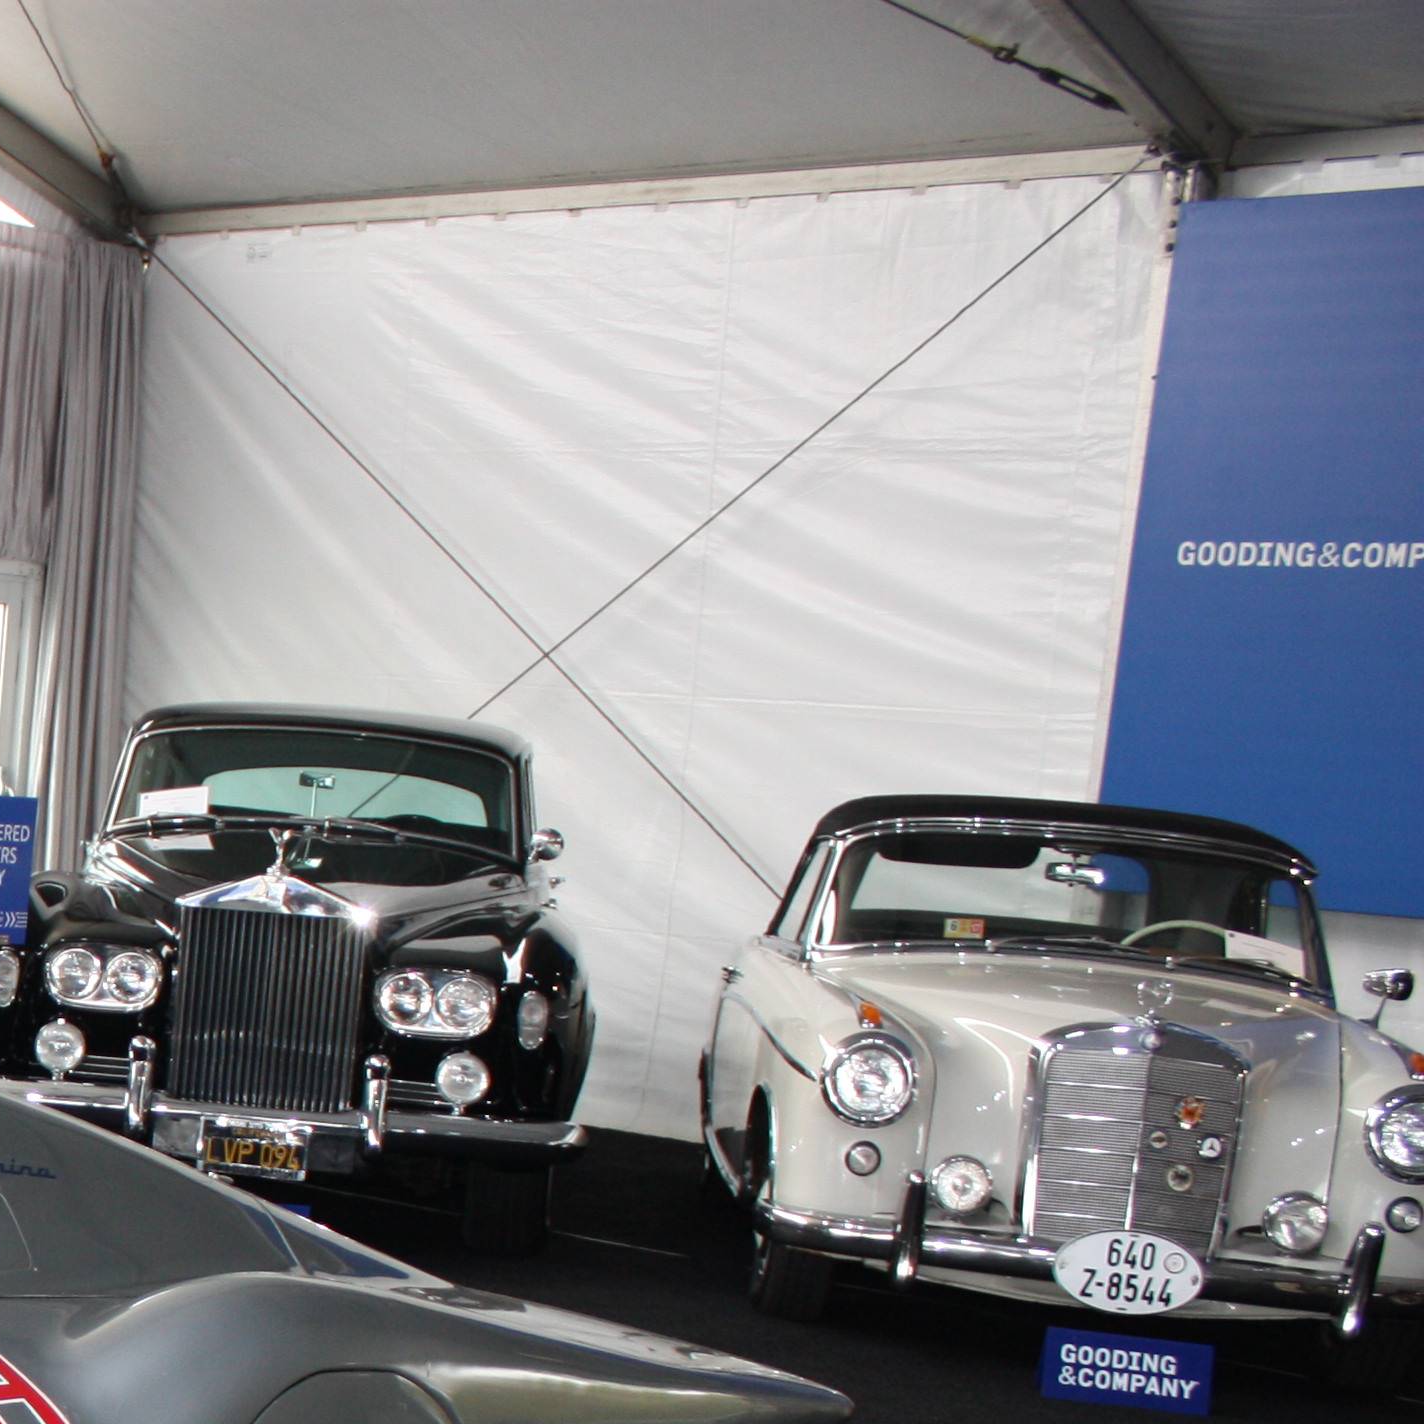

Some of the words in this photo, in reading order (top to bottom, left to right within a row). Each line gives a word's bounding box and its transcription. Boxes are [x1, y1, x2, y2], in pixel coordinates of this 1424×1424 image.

[1106, 1238, 1157, 1271] 640
[1079, 1268, 1173, 1308] Z-8544
[1060, 1343, 1177, 1376] GOODING
[1057, 1365, 1199, 1400] &COMPANY
